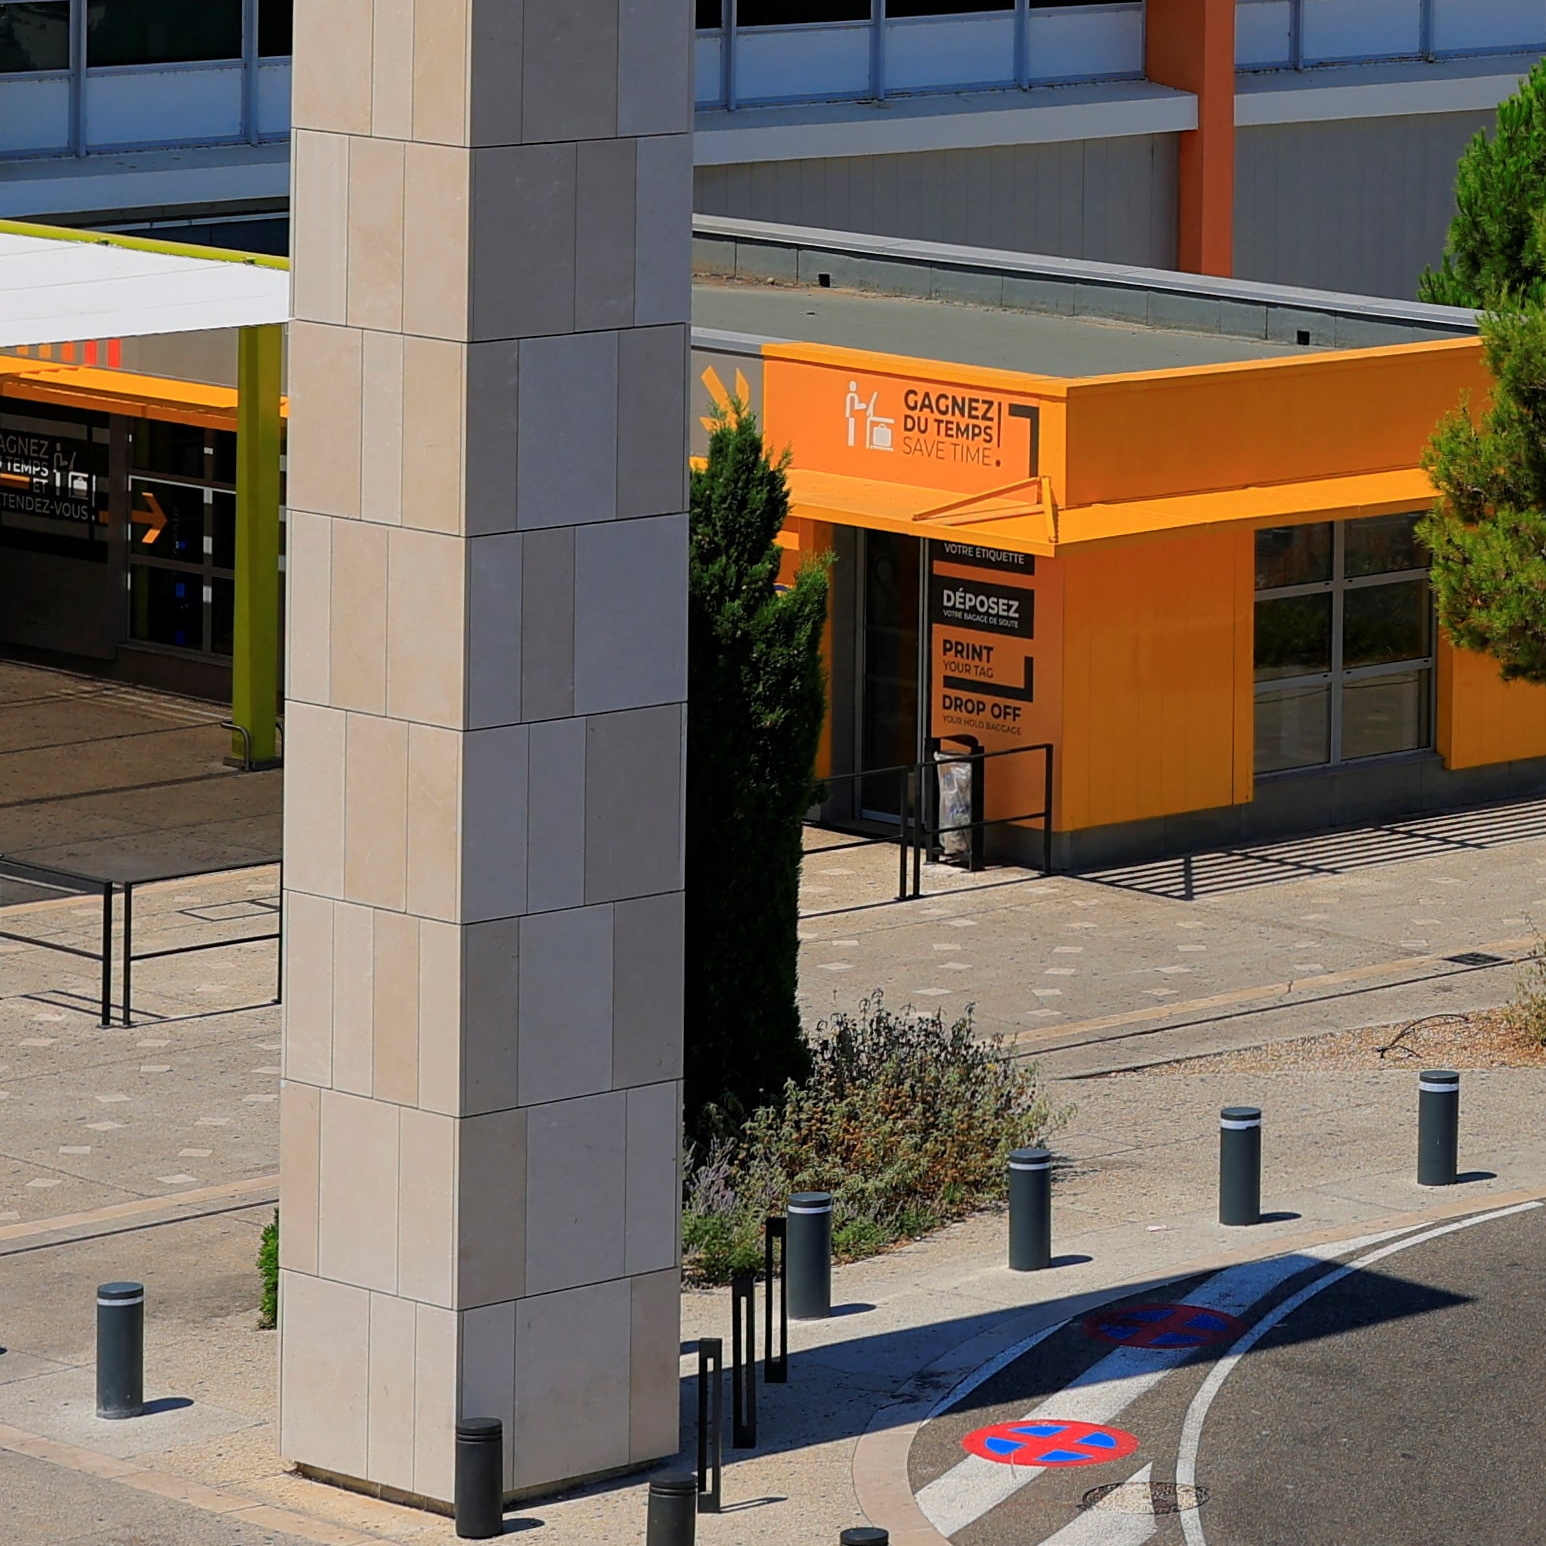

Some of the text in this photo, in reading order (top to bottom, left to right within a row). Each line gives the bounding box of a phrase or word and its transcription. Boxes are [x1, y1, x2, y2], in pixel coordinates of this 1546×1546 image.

[904, 389, 994, 422] GAGNEZ
[904, 414, 993, 443] DU TEMPS
[903, 436, 992, 467] SAVE TIME
[6, 456, 49, 477] TEMPS
[33, 477, 48, 494] ET
[944, 542, 974, 557] VOTRE
[943, 587, 1019, 618] DÉPOSEZ
[943, 609, 1019, 629] VOTRE BAGAGE DE SOUTE
[943, 639, 994, 664] PRINT
[943, 660, 994, 679] YOUR TAG
[943, 694, 1022, 722] DROP OFF
[943, 715, 1022, 736] YOUR HOLD BAGGAGE
